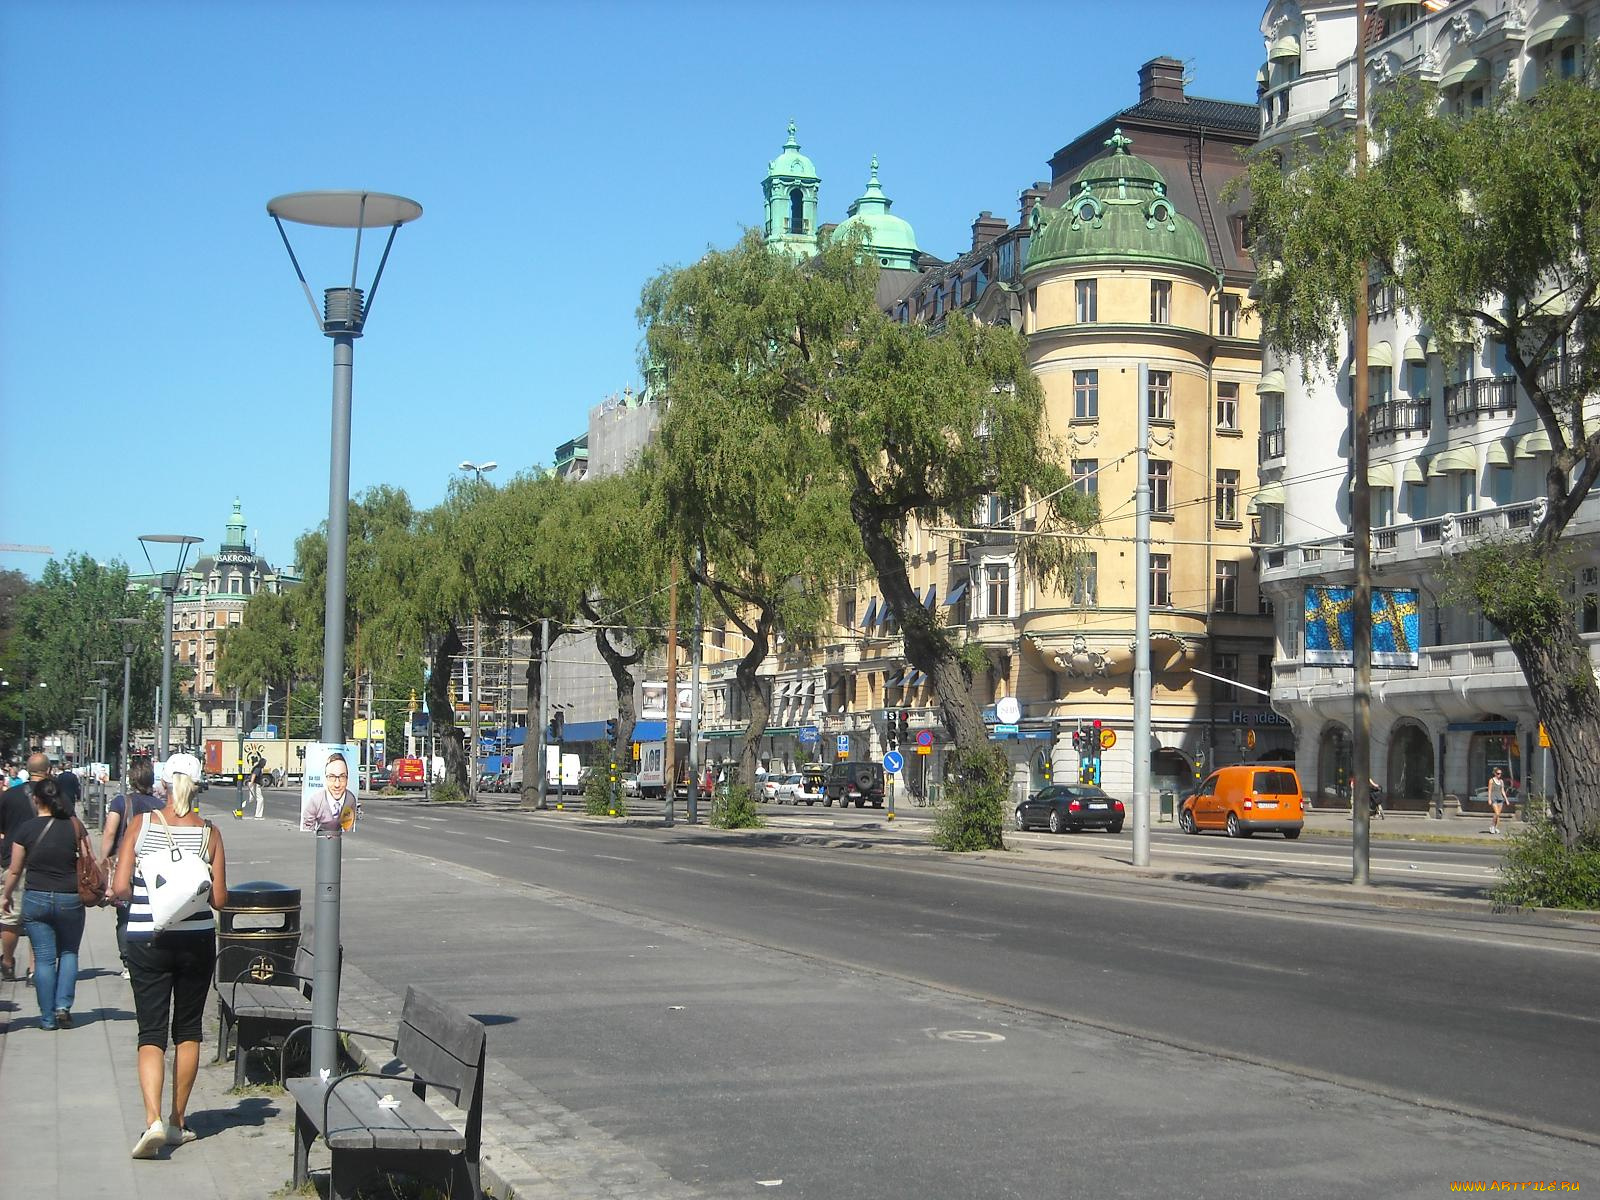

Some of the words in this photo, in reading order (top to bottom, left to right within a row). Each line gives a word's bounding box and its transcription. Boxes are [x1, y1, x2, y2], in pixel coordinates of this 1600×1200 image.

[888, 712, 895, 720] S
[1232, 710, 1289, 724] Handels
[244, 743, 265, 753] GWG
